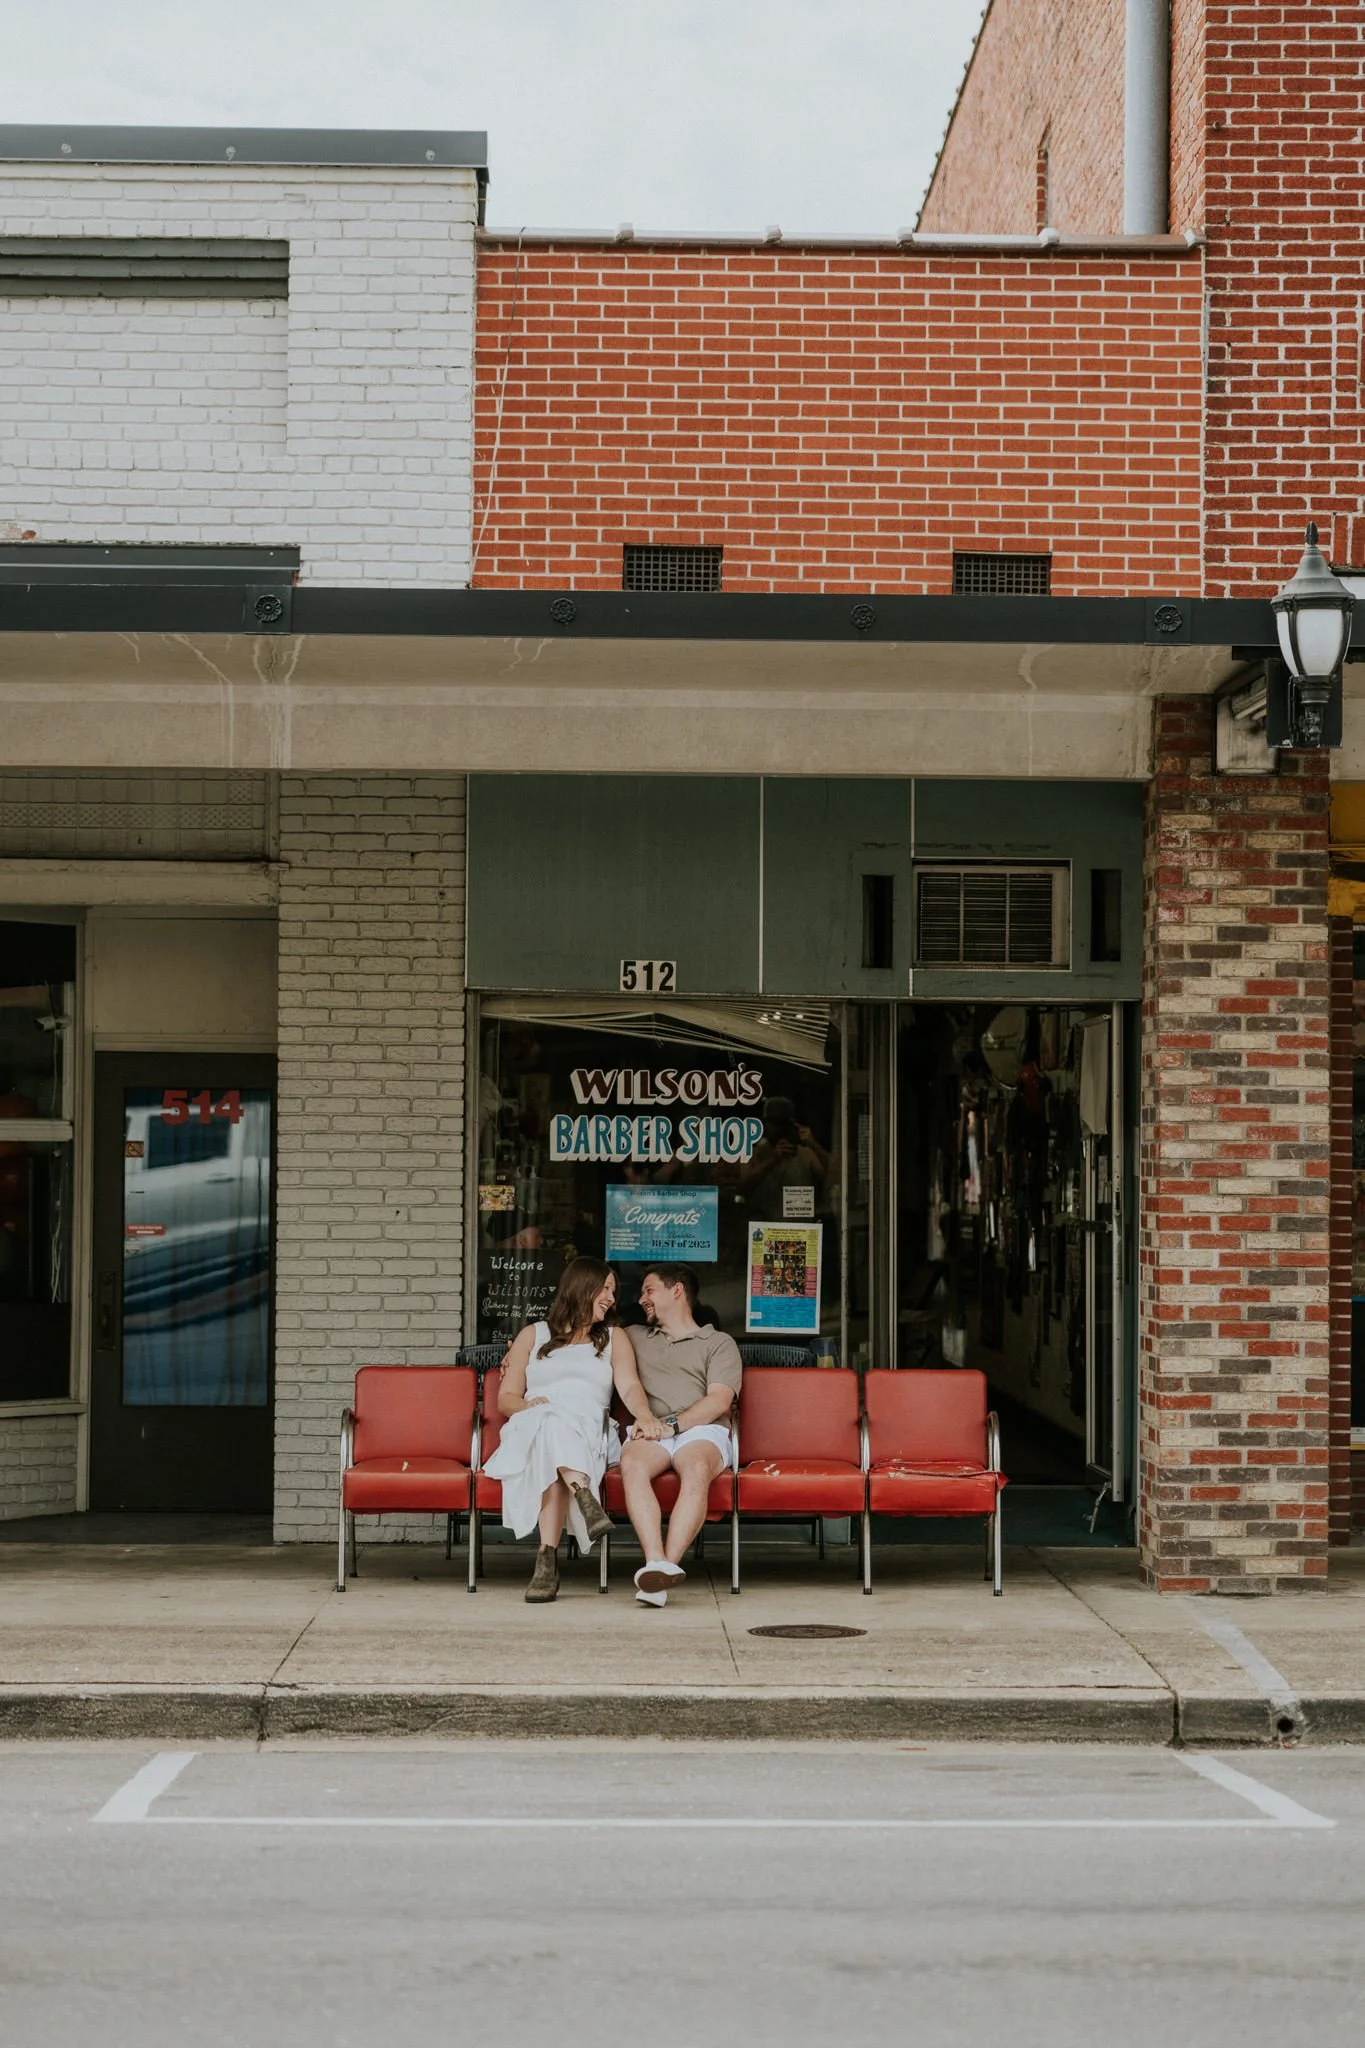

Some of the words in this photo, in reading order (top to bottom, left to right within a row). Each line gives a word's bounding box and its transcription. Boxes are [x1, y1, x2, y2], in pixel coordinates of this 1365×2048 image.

[622, 960, 676, 992] 512
[570, 1062, 764, 1106] WILSON'S
[160, 1089, 245, 1125] 514
[550, 1114, 673, 1162] BARBER
[674, 1115, 764, 1163] SHOP
[625, 1205, 701, 1231] Congrats
[652, 1239, 675, 1249] BEST
[677, 1239, 688, 1249] of
[490, 1256, 544, 1271] Welcome
[508, 1272, 520, 1281] to
